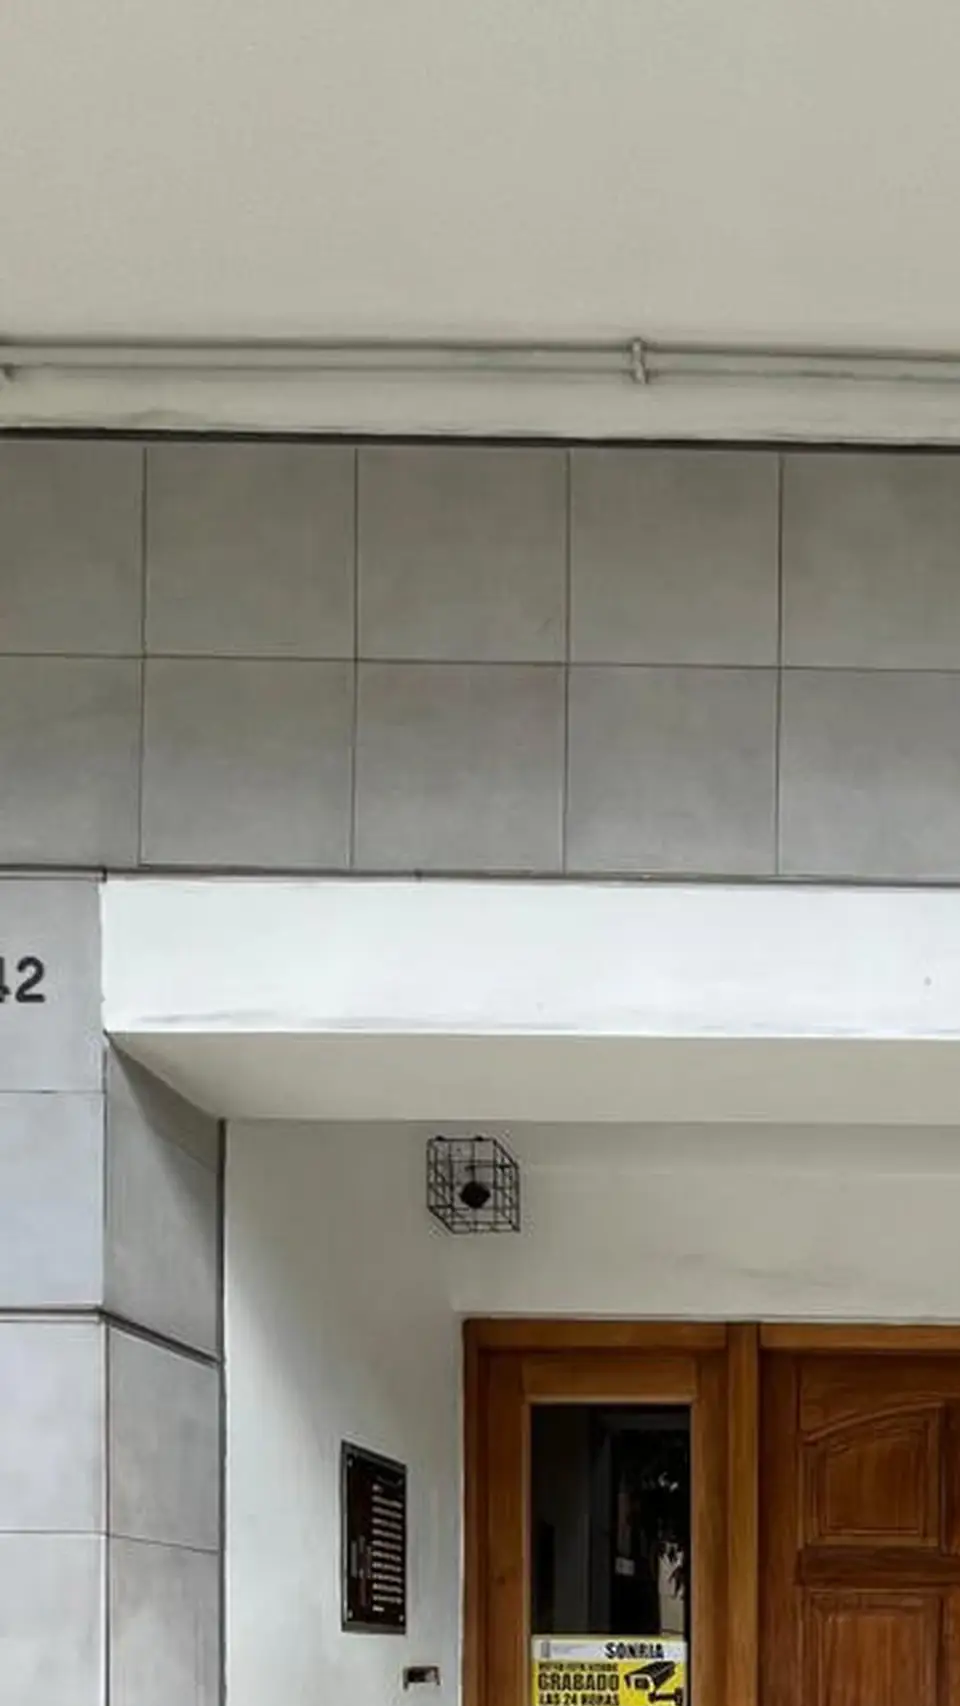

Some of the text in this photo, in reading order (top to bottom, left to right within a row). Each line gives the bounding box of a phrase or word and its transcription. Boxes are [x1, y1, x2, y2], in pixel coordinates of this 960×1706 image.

[538, 1673, 620, 1691] GRABADO
[538, 1692, 620, 1706] LAS 24 HORAS
